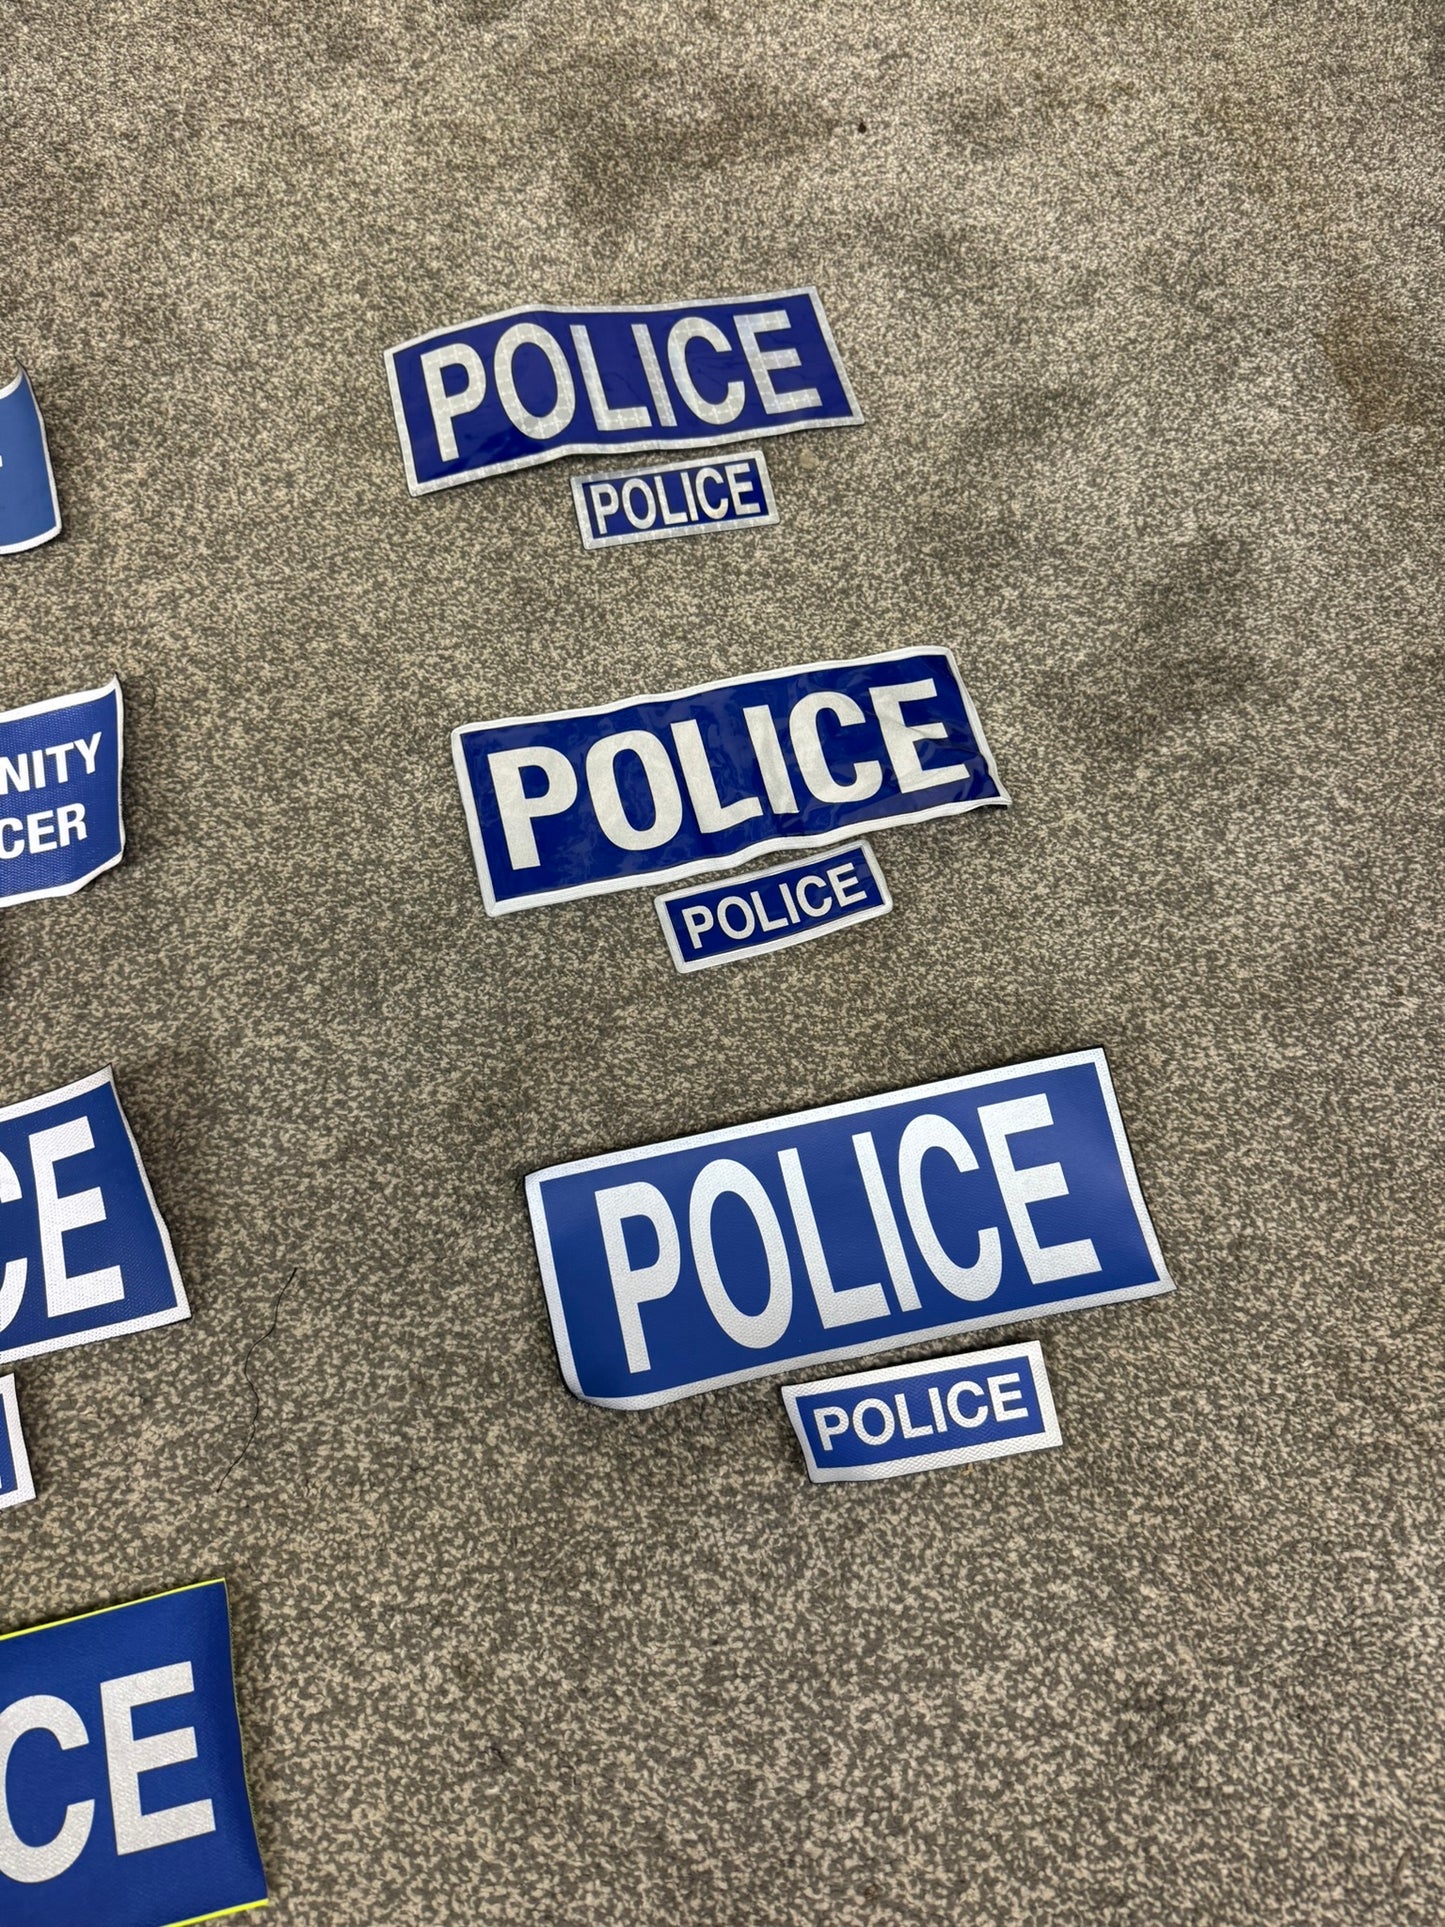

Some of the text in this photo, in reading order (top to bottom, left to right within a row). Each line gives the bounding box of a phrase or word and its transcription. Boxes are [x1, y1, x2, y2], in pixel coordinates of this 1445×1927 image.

[418, 309, 823, 462] POLICE
[589, 461, 762, 535] POLICE
[0, 731, 102, 796] NITY
[486, 678, 971, 870] POLICE
[0, 802, 88, 860] CER
[680, 861, 870, 950] POLICE
[594, 1093, 1103, 1375] POLICE
[813, 1372, 1030, 1452] POLICE
[0, 1660, 216, 1884] CE
